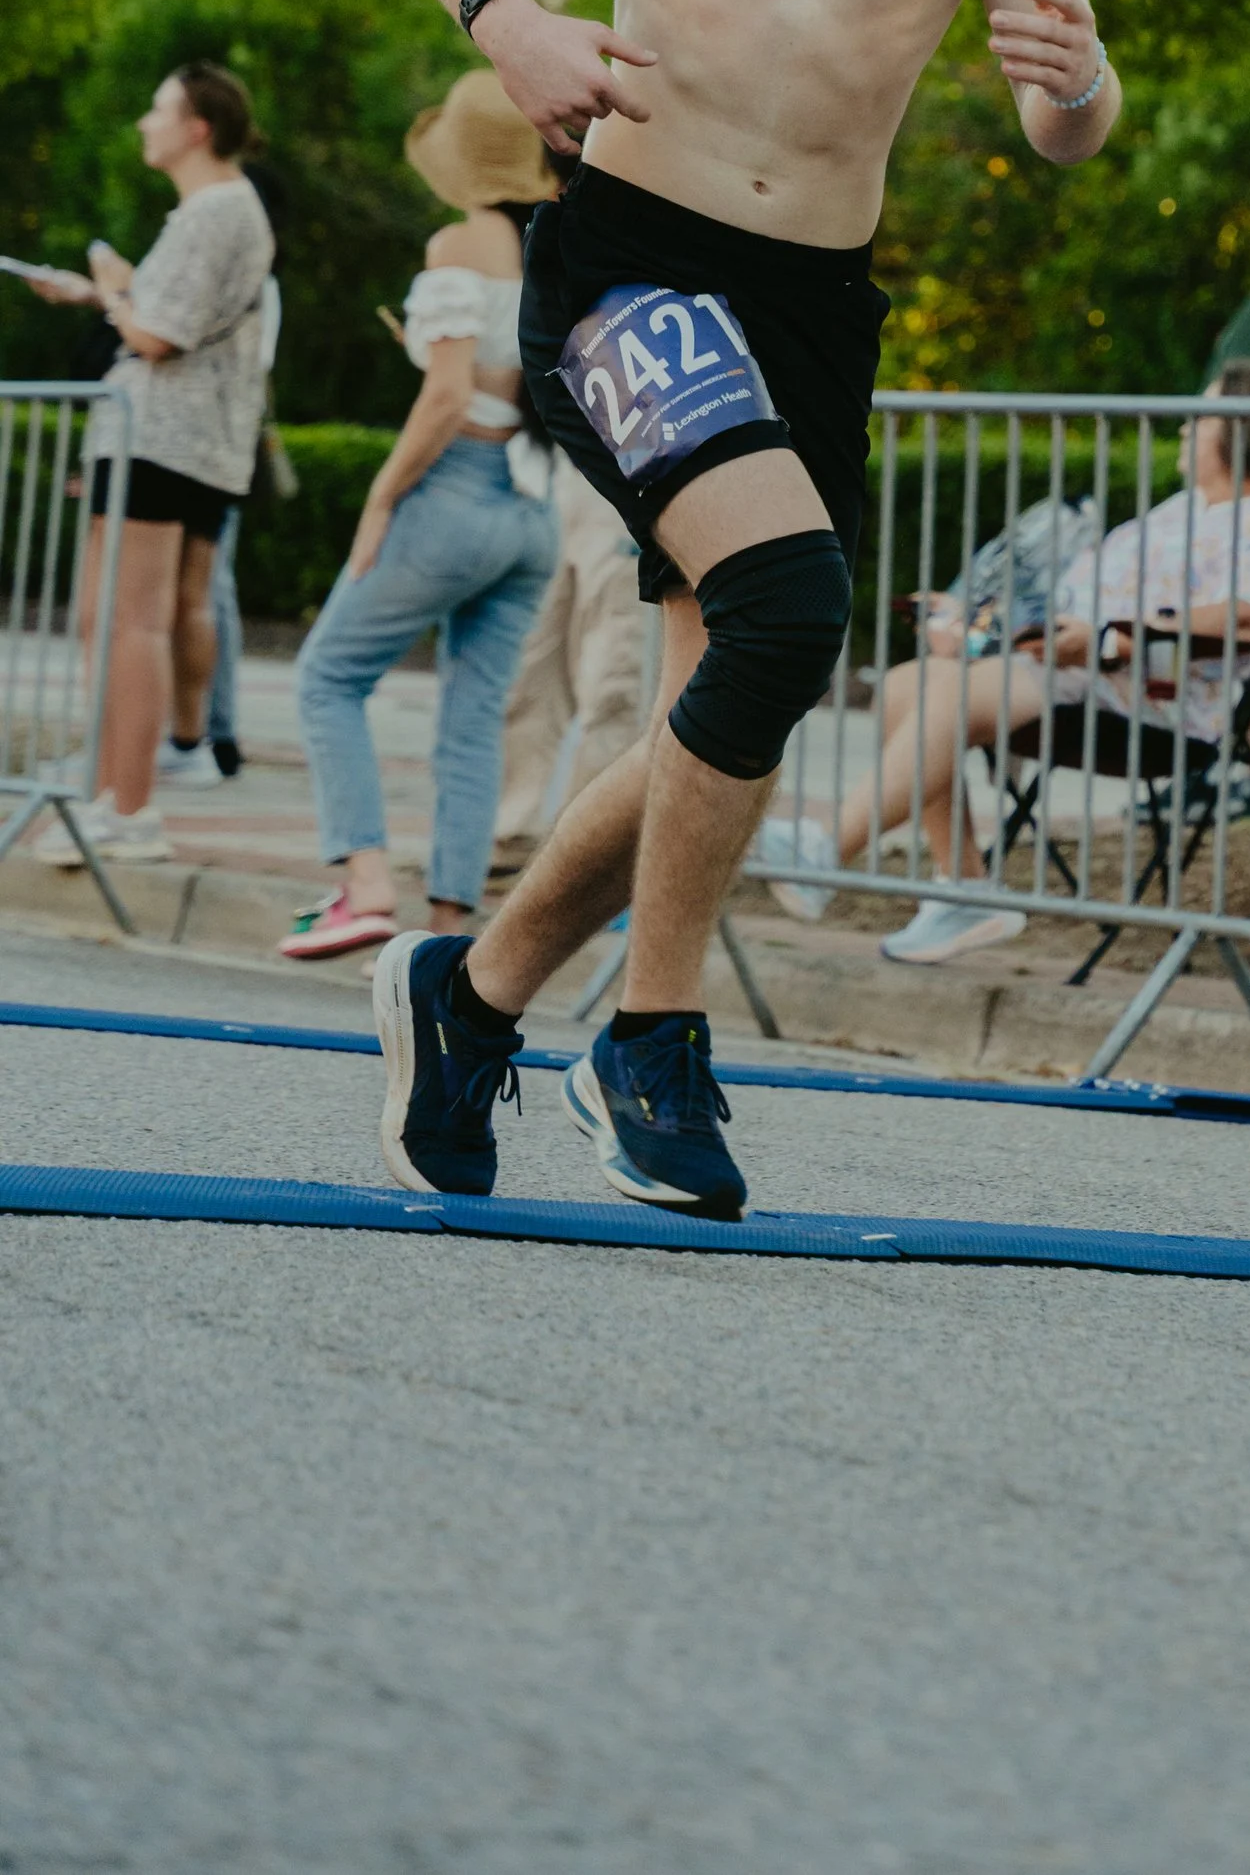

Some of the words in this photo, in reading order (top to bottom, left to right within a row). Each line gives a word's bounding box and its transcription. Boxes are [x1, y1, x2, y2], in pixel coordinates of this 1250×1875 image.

[581, 327, 607, 359] Tunnel
[604, 302, 639, 330] Towers
[633, 288, 675, 308] Founda
[584, 293, 749, 446] 2421
[674, 397, 723, 431] Lexington
[720, 388, 752, 405] Health
